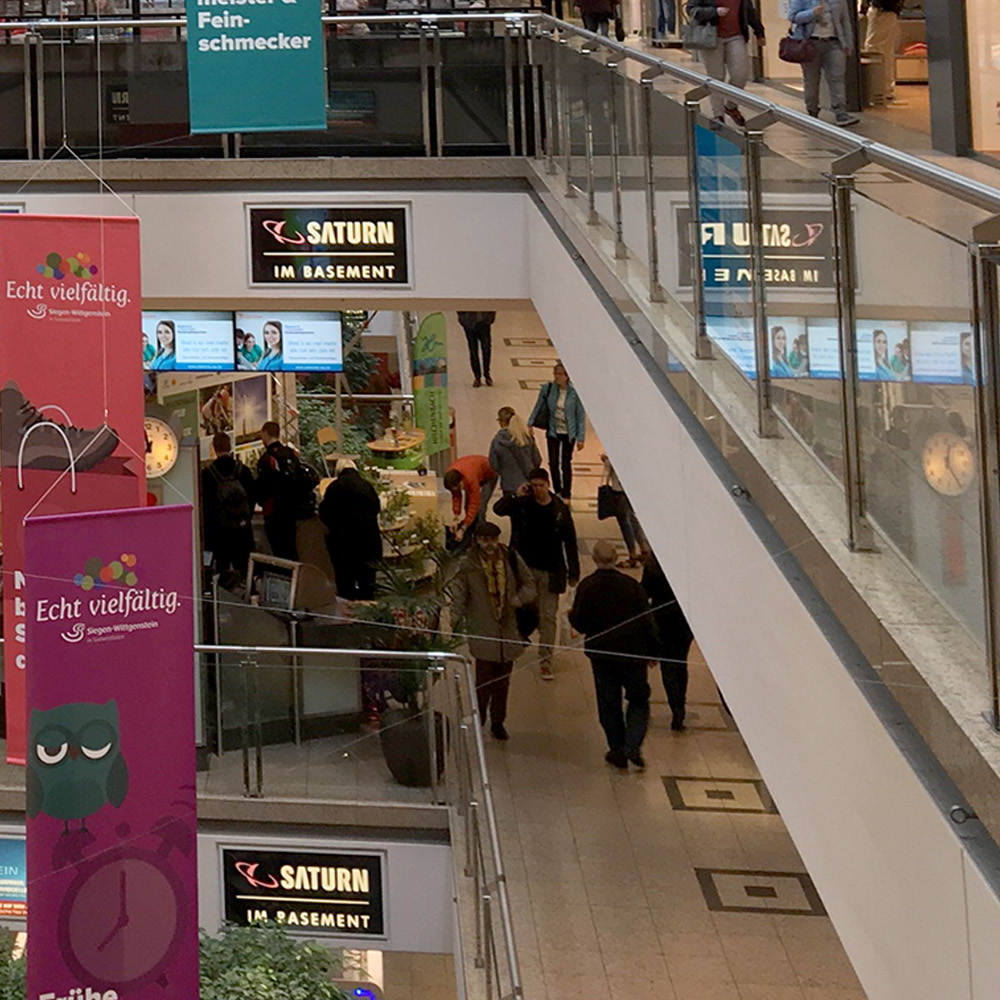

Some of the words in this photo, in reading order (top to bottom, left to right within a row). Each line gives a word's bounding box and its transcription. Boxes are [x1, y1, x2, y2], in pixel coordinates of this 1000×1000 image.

[198, 10, 250, 28] Fein-
[198, 33, 312, 52] schmecker
[306, 221, 394, 244] SATURN
[274, 265, 295, 278] IM
[303, 265, 395, 279] BASEMENT
[6, 281, 44, 299] Echt
[50, 282, 131, 308] vielfältig.
[36, 597, 81, 621] Echt
[89, 588, 181, 618] vielfältig.
[280, 865, 369, 893] SATURN
[247, 909, 268, 923] IM
[277, 910, 370, 929] BASEMENT
